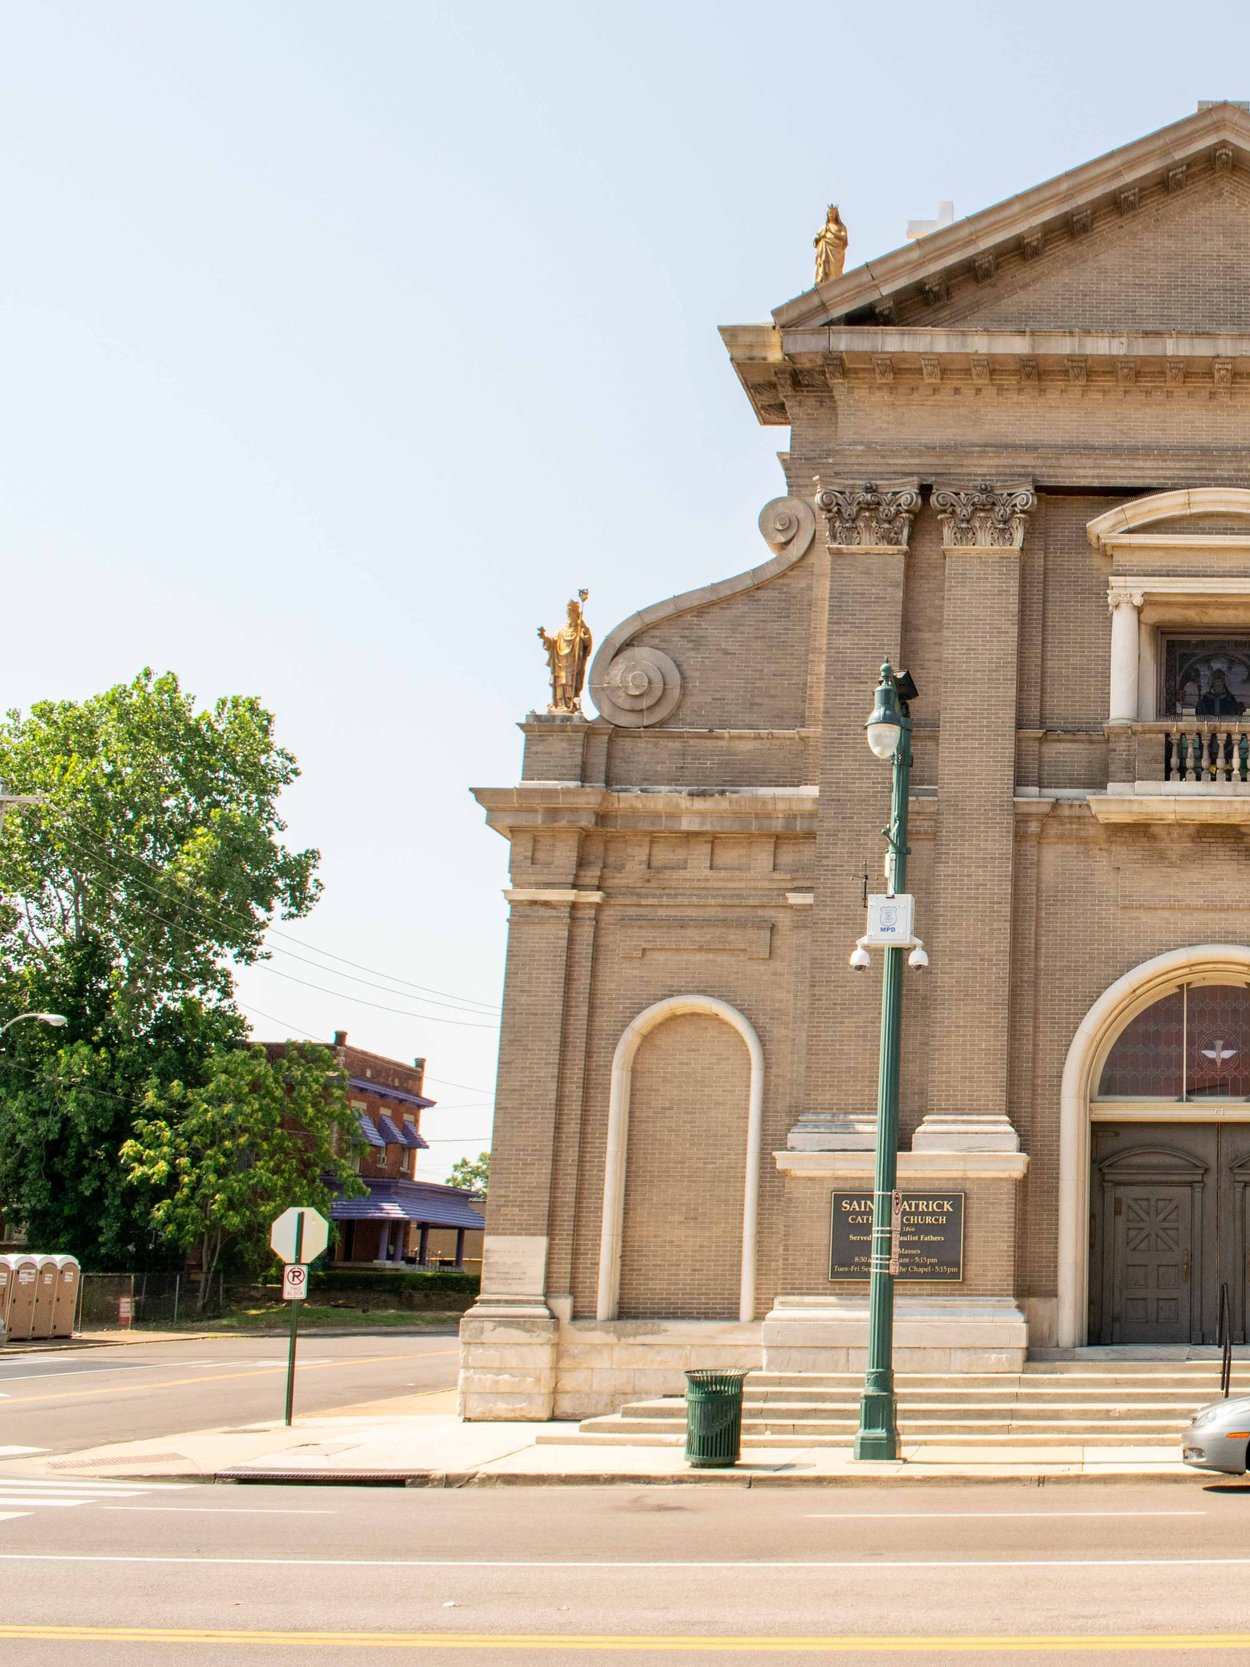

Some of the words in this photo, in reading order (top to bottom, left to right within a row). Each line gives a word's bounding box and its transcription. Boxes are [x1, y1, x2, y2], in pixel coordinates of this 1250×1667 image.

[841, 1199, 875, 1212] SAIN
[900, 1200, 954, 1212] ATRICK
[903, 1215, 947, 1224] CHURCH
[909, 1265, 931, 1274] Chapel
